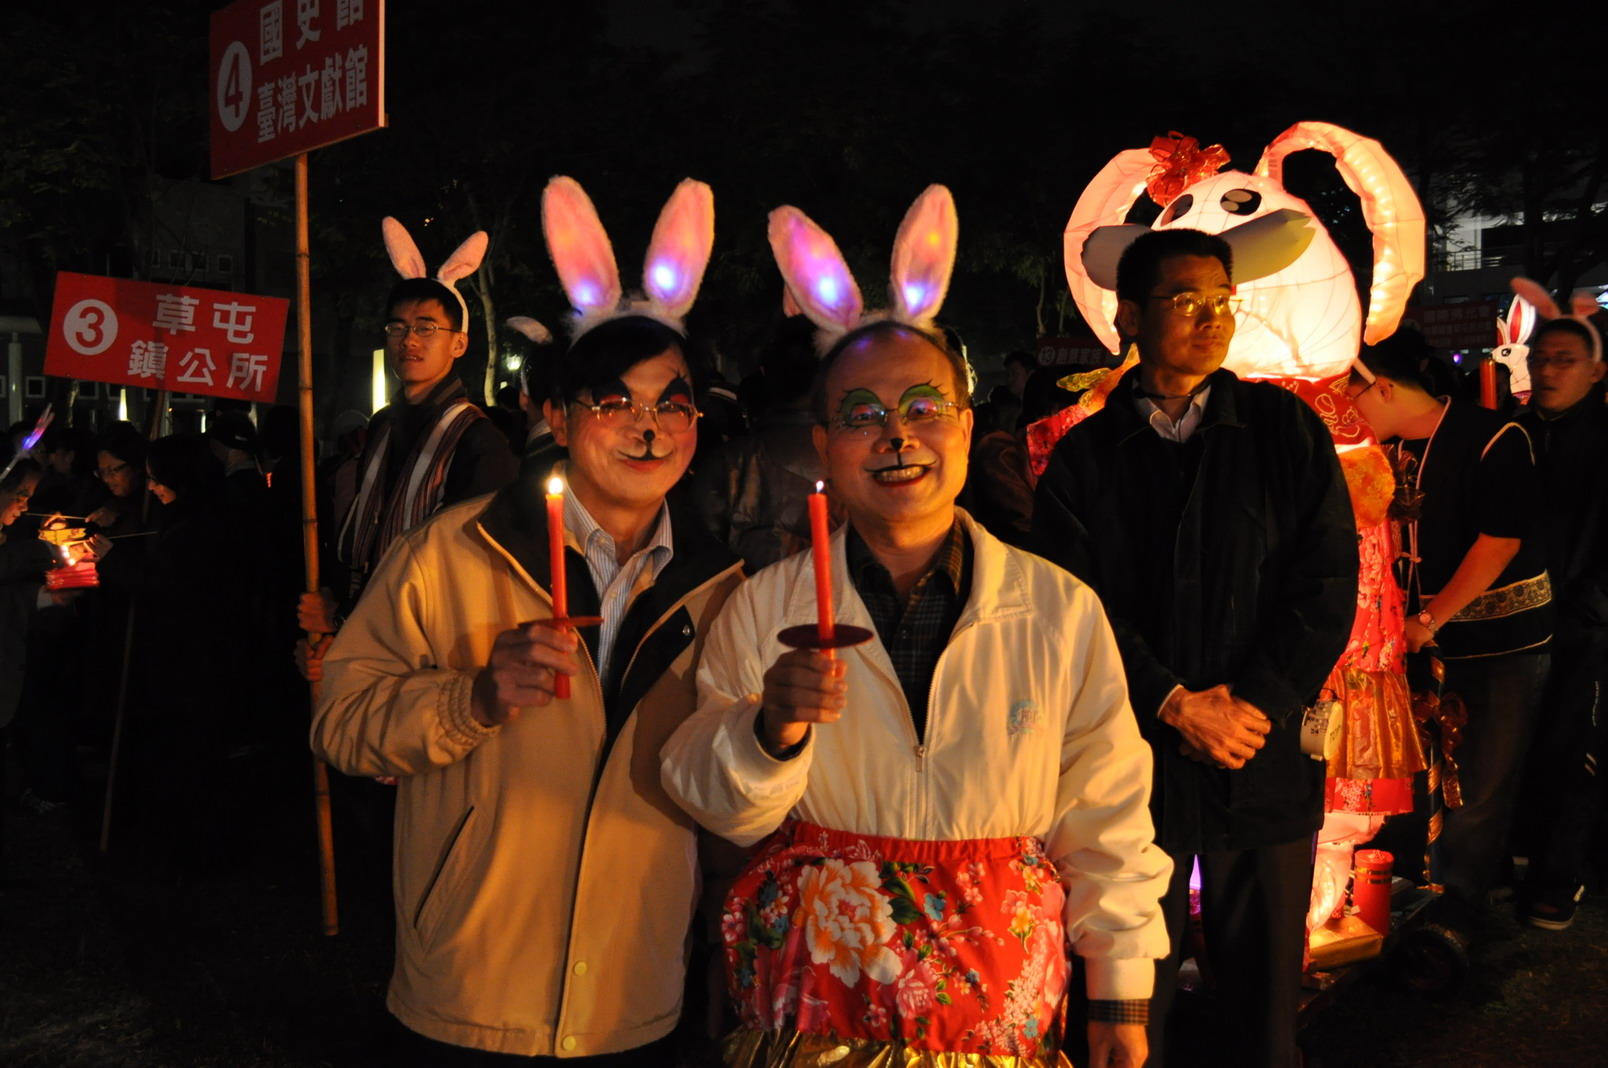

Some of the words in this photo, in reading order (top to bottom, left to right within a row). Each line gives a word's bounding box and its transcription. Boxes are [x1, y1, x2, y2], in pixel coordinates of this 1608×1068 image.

[222, 50, 246, 120] 4
[256, 43, 369, 144] 臺灣文獻館
[74, 304, 107, 351] 3
[152, 292, 257, 345] 草屯
[127, 339, 269, 393] 鎮公所
